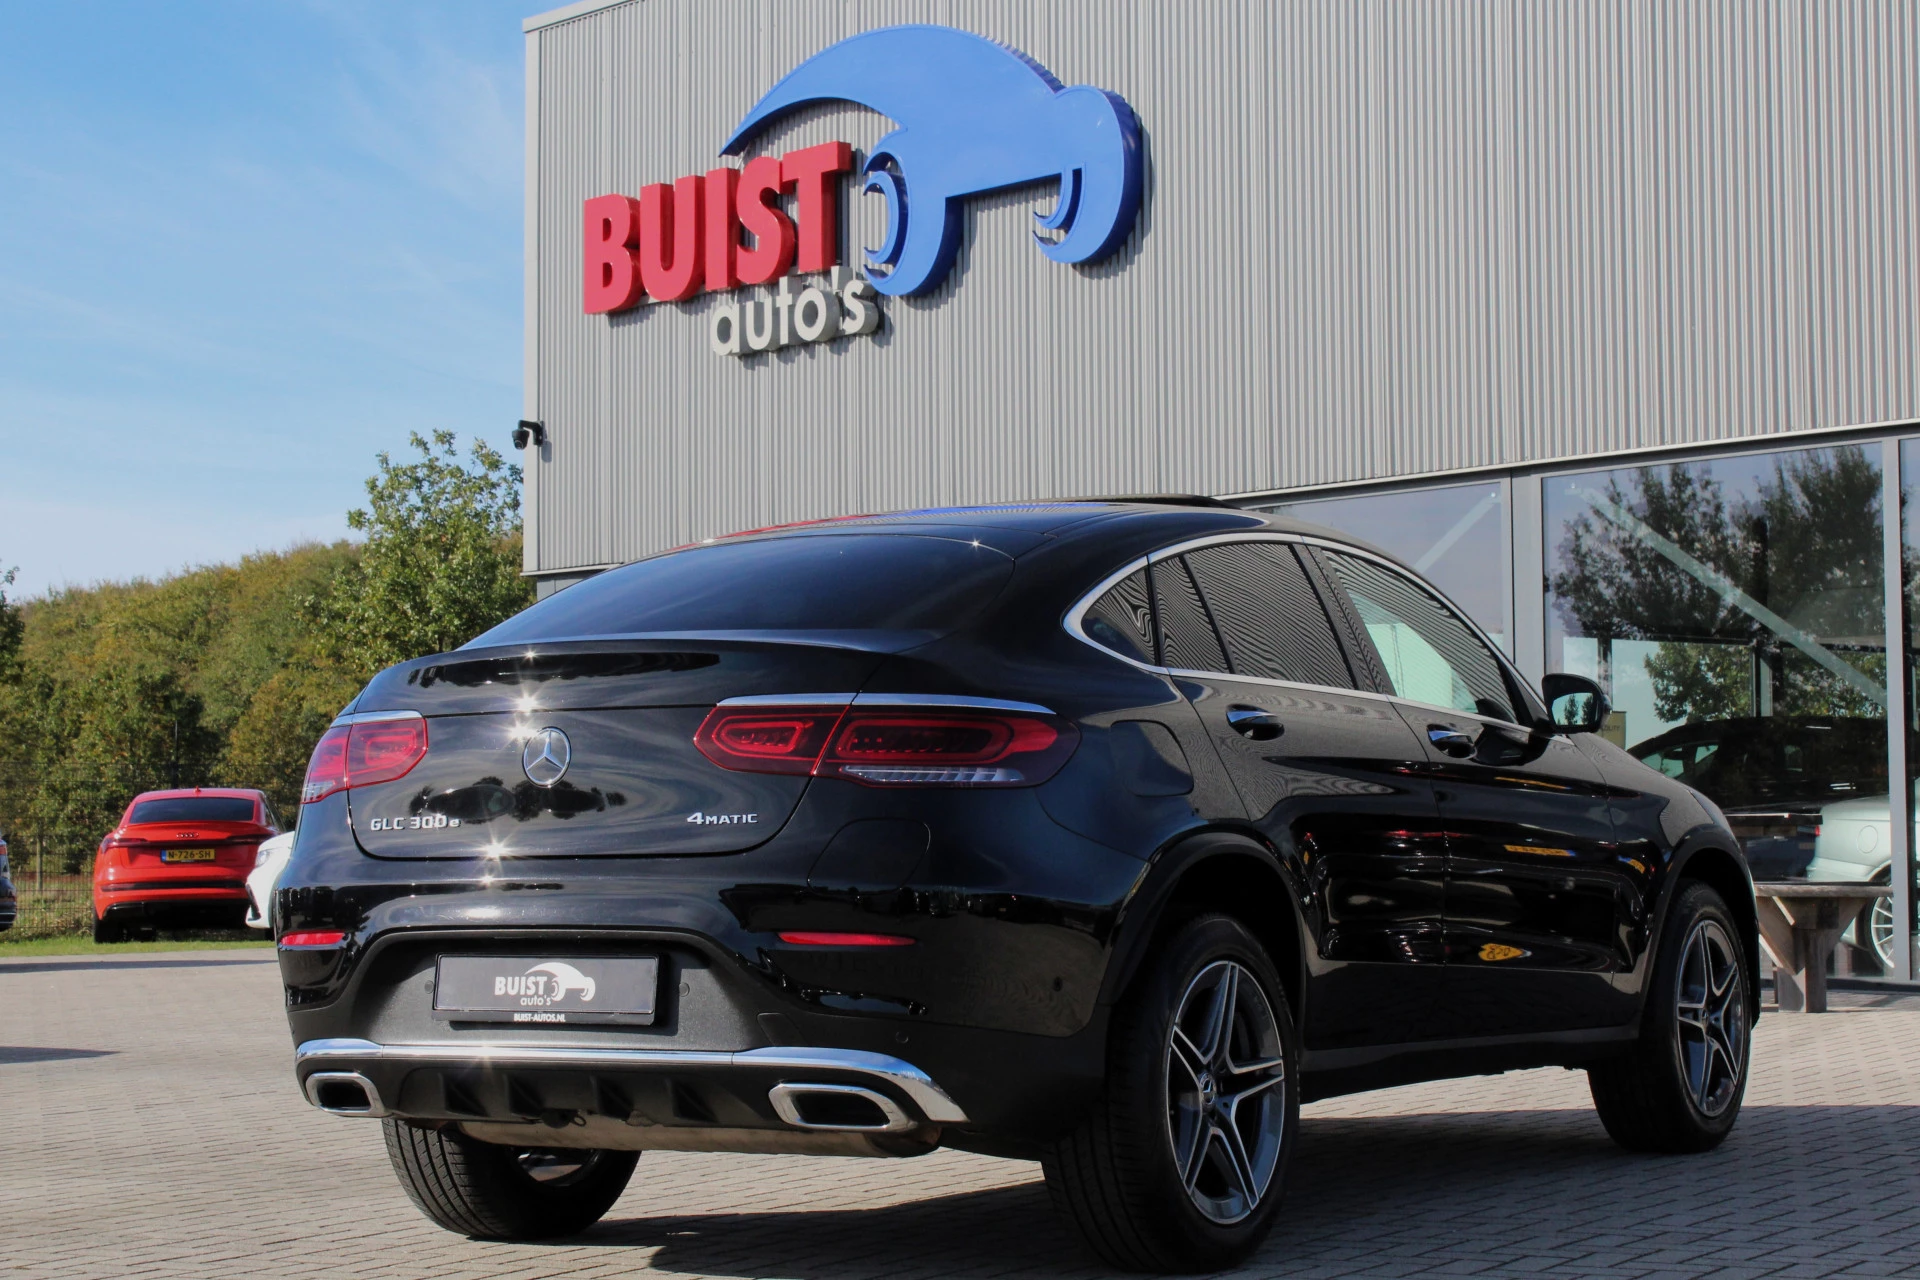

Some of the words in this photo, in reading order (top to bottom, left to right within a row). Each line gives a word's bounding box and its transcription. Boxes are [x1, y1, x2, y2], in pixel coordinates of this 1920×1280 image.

[584, 140, 850, 314] BUIST
[711, 265, 878, 356] auto's
[370, 817, 404, 831] GLC
[687, 812, 758, 825] 4MATIC
[168, 850, 211, 859] N-726-SH
[495, 976, 548, 996] BUIST
[520, 995, 552, 1006] auto's
[513, 1013, 566, 1022] BUIST-AUTOS.NL
